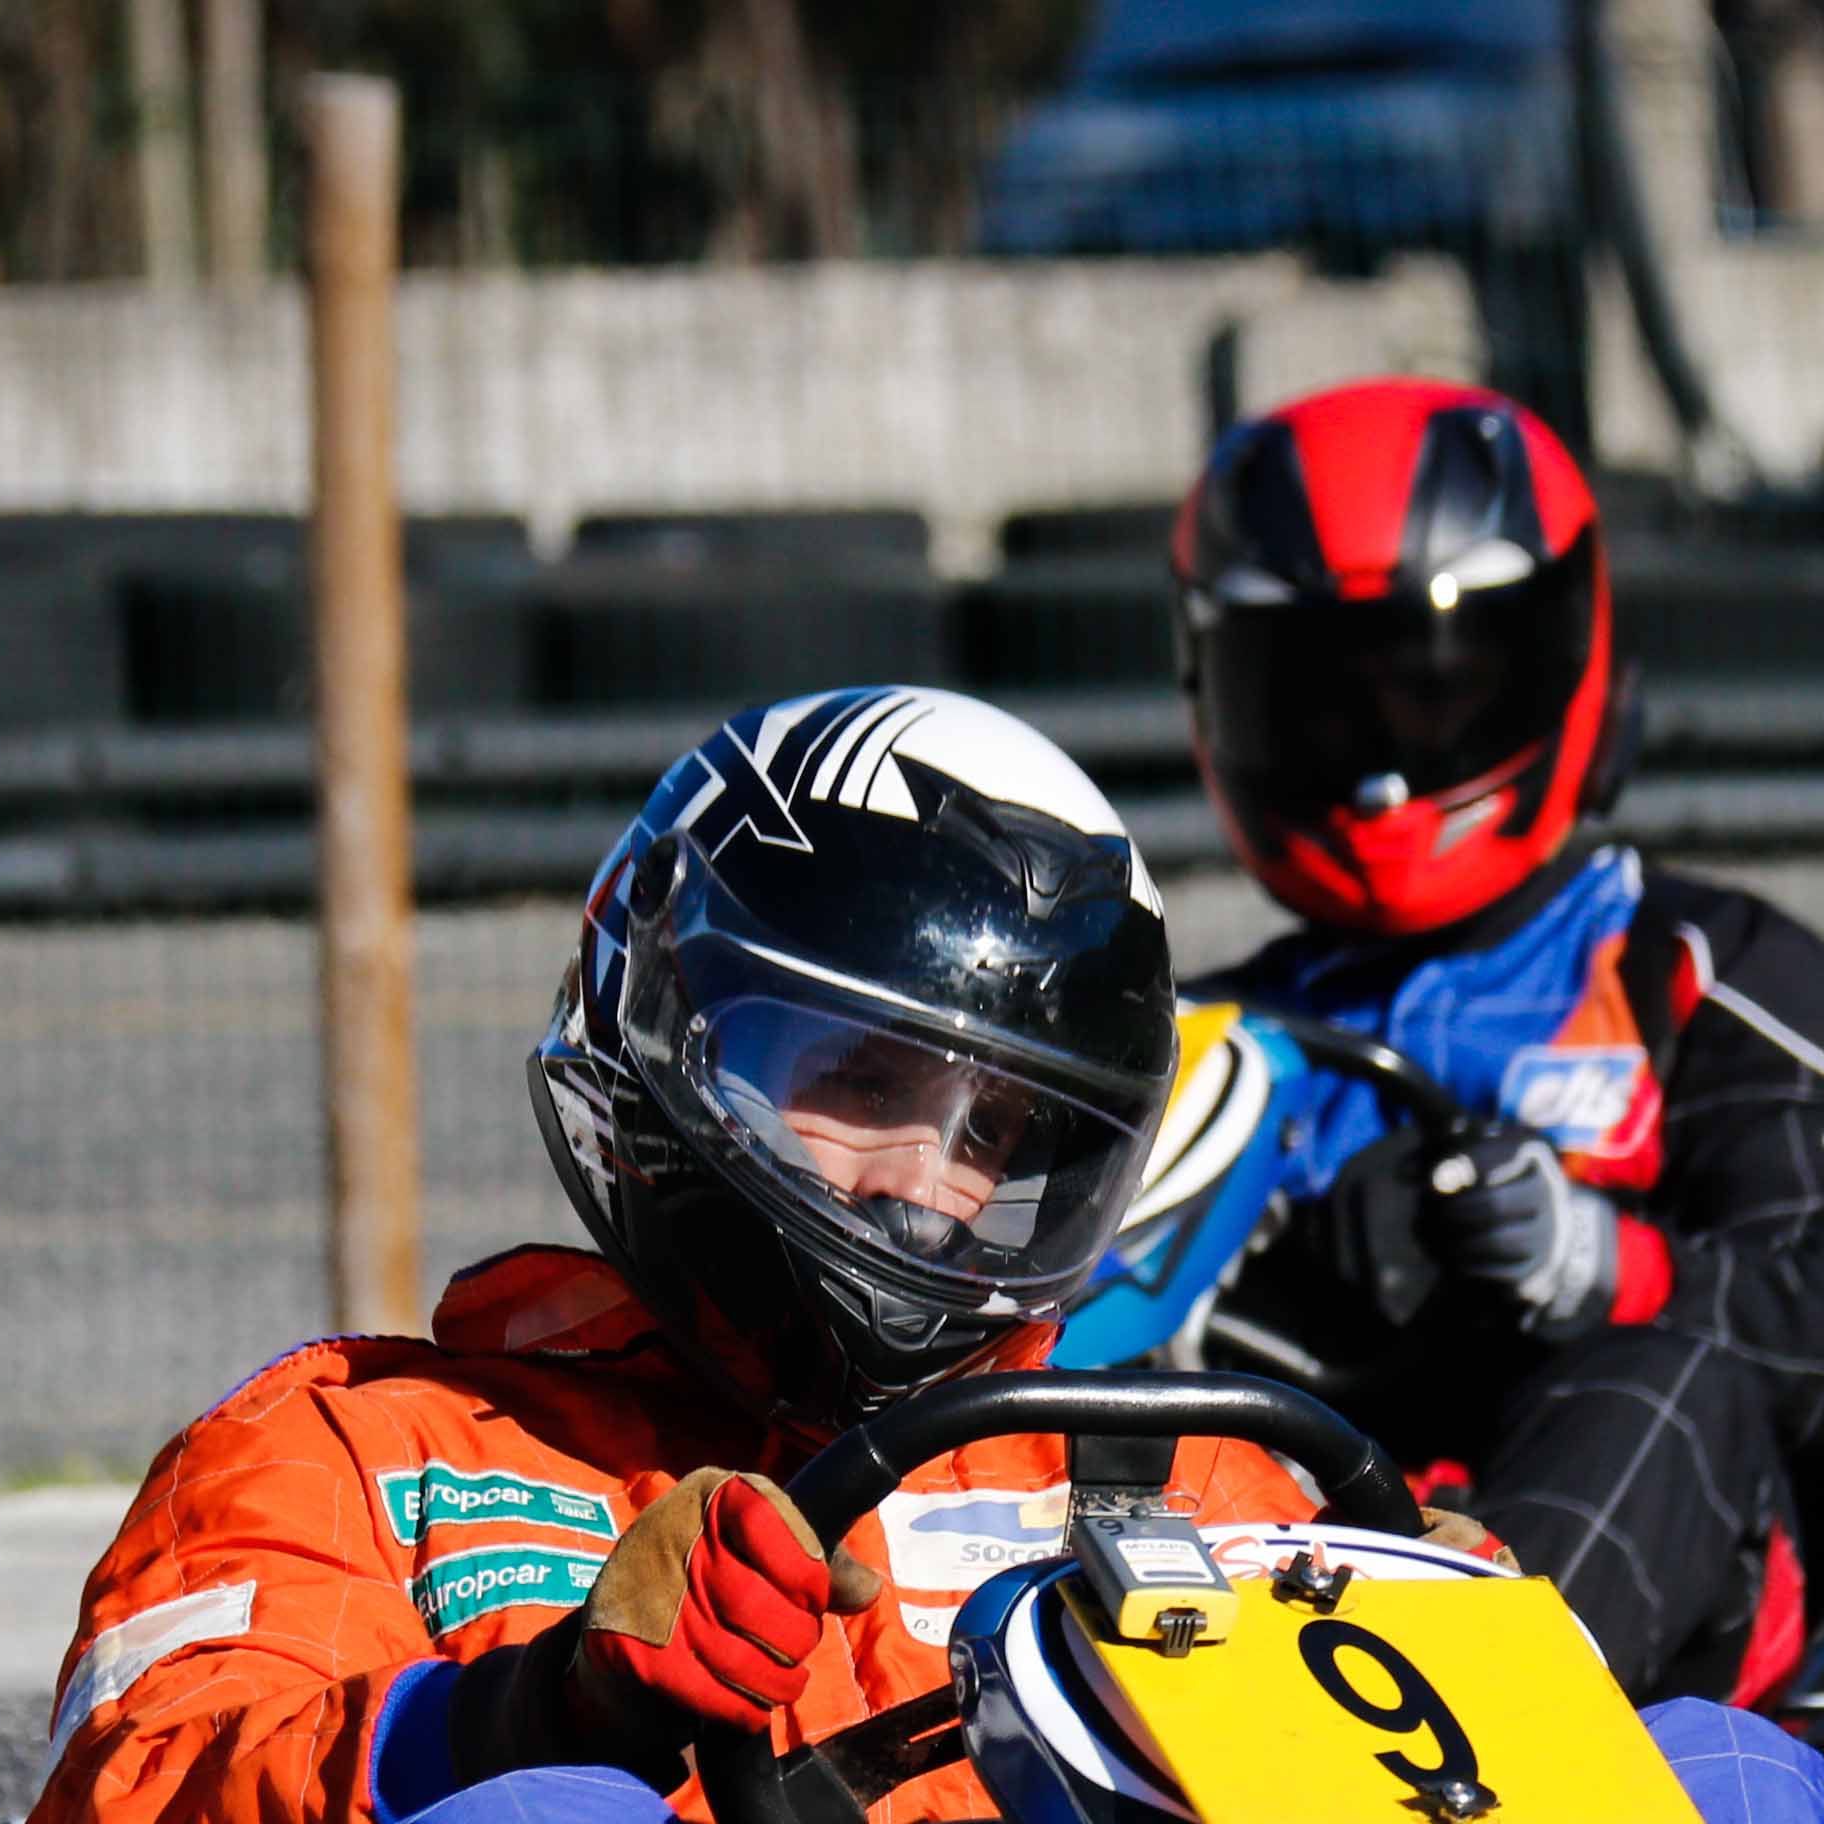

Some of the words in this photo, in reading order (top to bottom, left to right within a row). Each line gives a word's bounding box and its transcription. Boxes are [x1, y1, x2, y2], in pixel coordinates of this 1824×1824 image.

[405, 1482, 534, 1521] Eropcar
[1098, 1519, 1125, 1536] 9
[1298, 1619, 1479, 1796] 9
